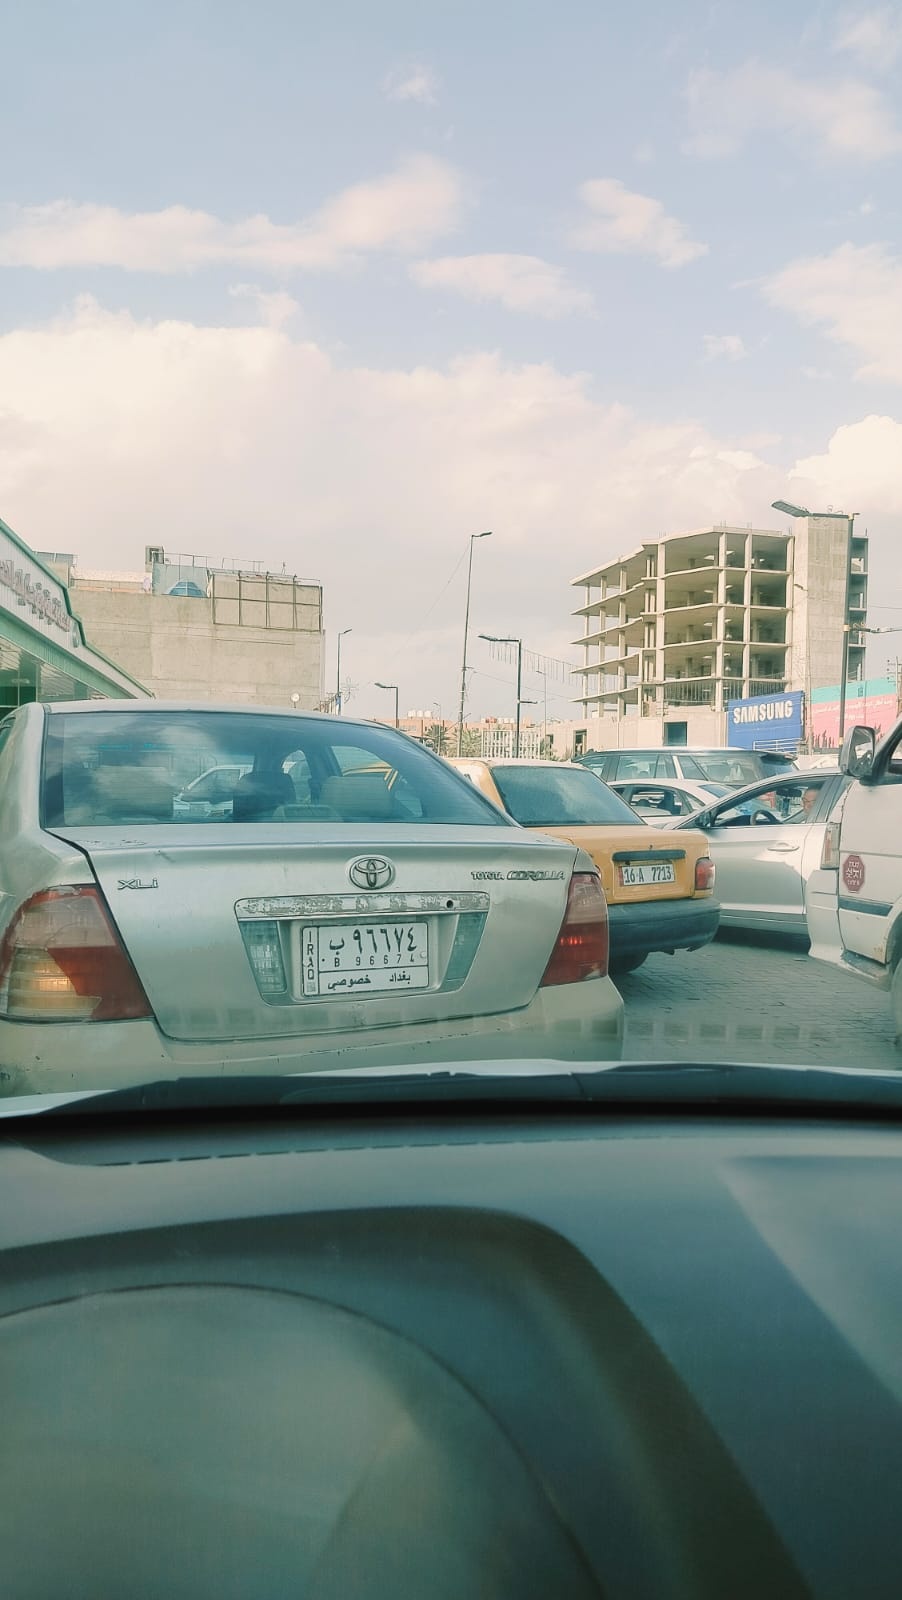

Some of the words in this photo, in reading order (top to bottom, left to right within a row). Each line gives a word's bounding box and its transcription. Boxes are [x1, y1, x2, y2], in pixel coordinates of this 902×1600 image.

[733, 700, 793, 724] SAMSUNG
[506, 870, 565, 881] COROLLA
[624, 868, 635, 883] 16
[651, 866, 671, 881] 7713
[353, 926, 417, 954] ٩٦٦٧٤
[327, 974, 371, 990] خصوصي
[389, 970, 411, 984] بغداد
